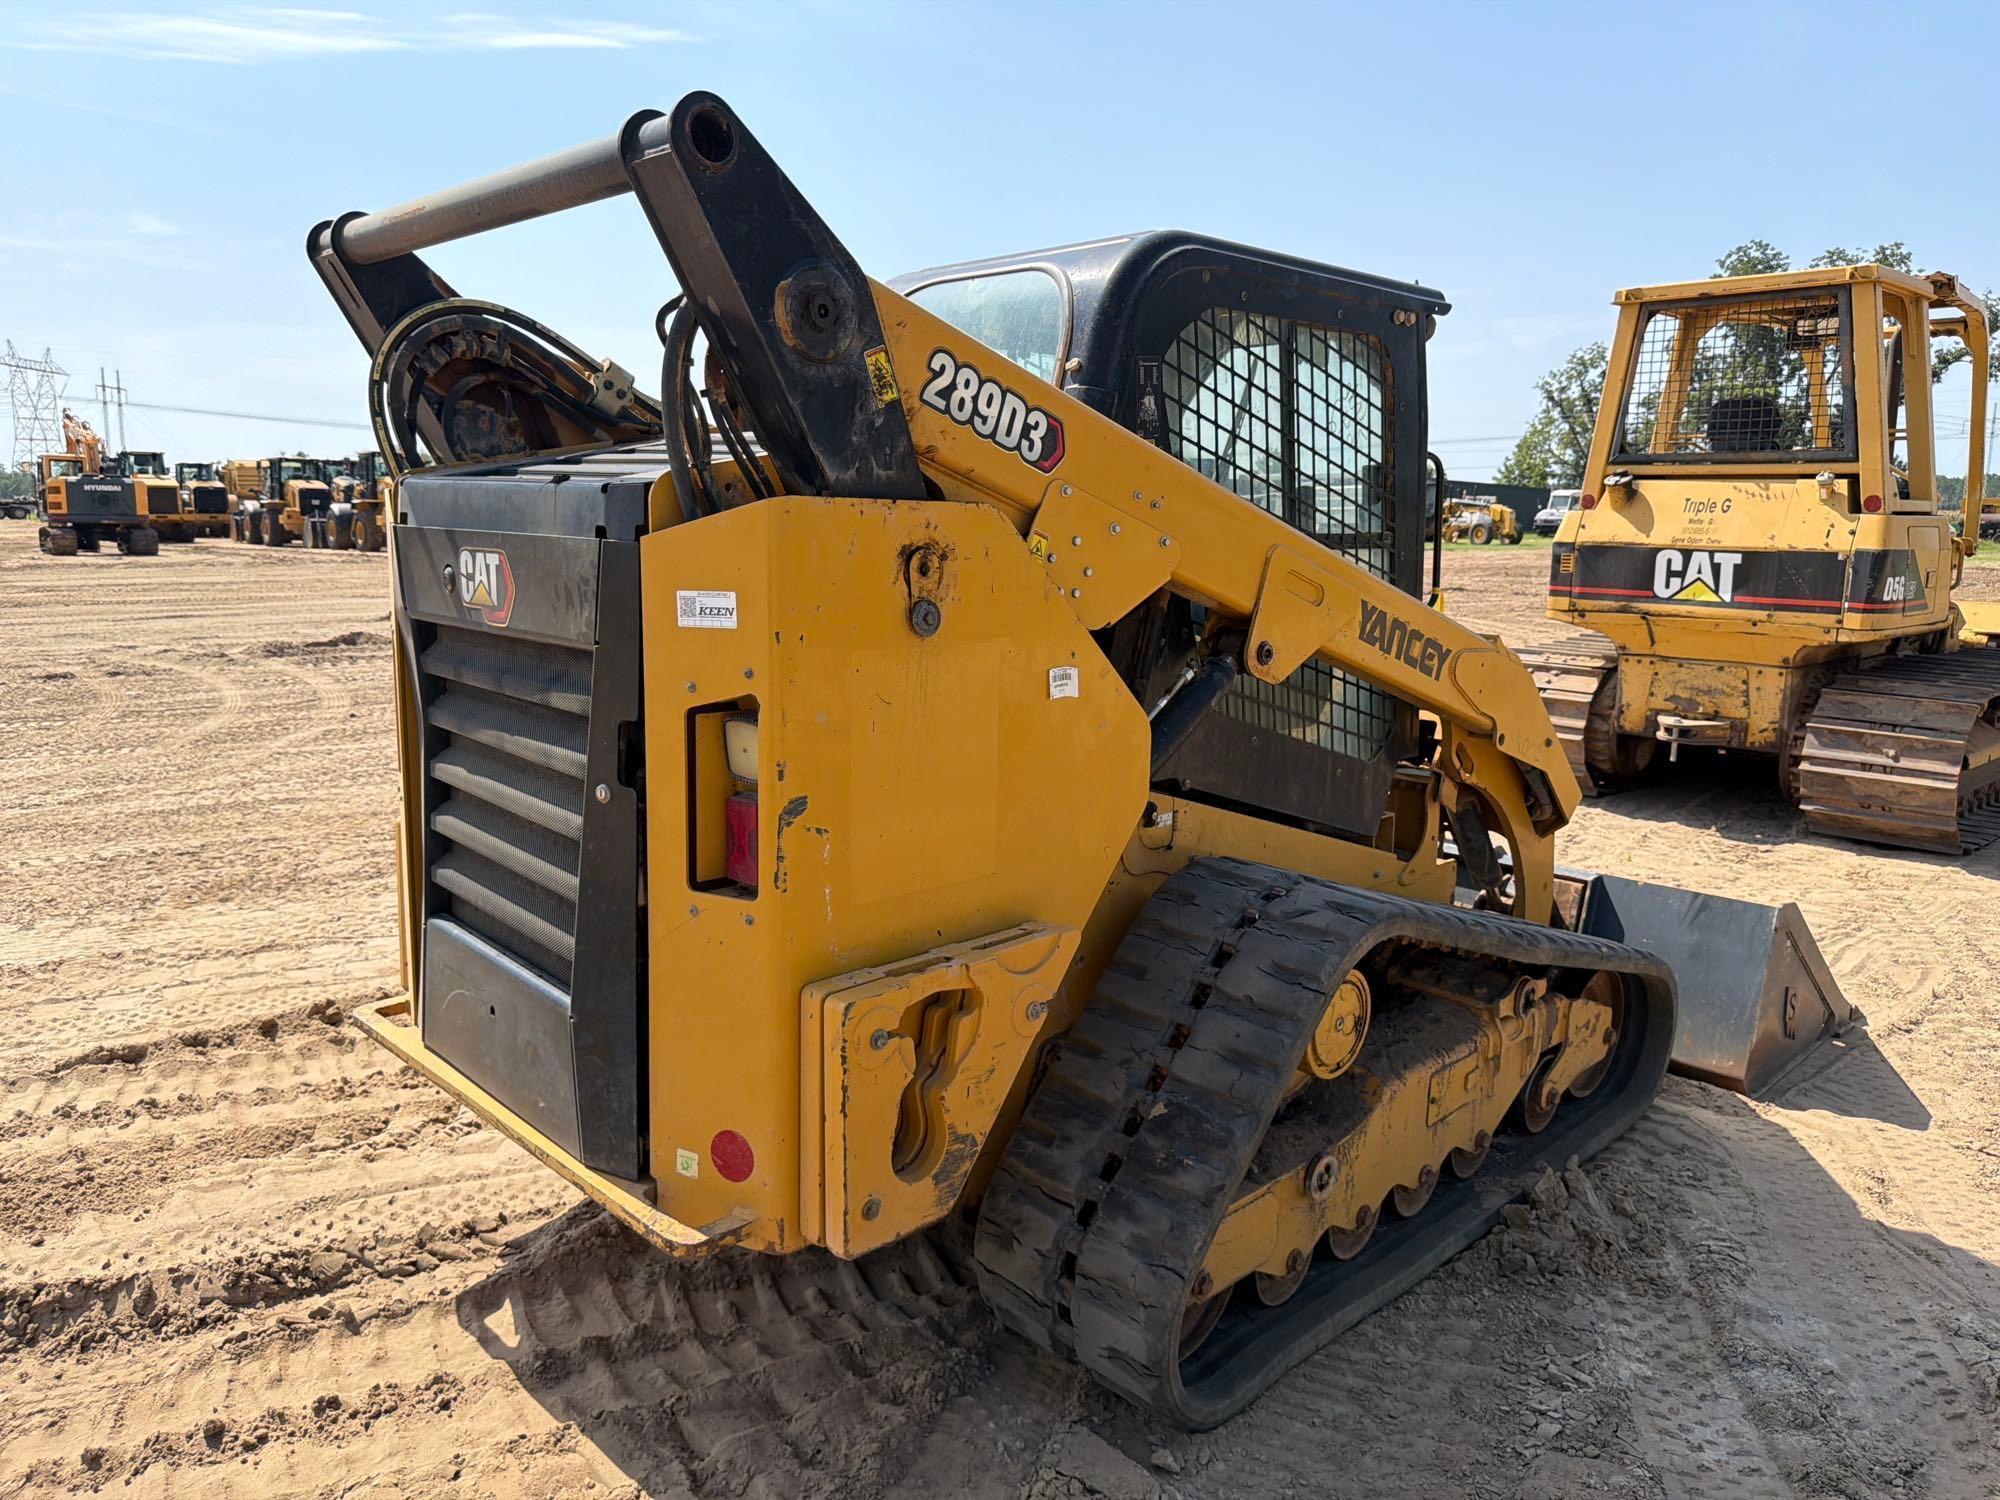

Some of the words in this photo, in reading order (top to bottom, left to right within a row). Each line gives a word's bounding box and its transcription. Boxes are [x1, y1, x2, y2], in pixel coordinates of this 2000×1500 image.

[921, 351, 1049, 463] 289D3
[1683, 497, 1717, 516] Triple
[1721, 498, 1732, 513] G
[459, 550, 500, 606] CAT
[1653, 549, 1743, 602] CAT
[698, 606, 735, 616] KEEN
[1359, 598, 1453, 682] YANCEY
